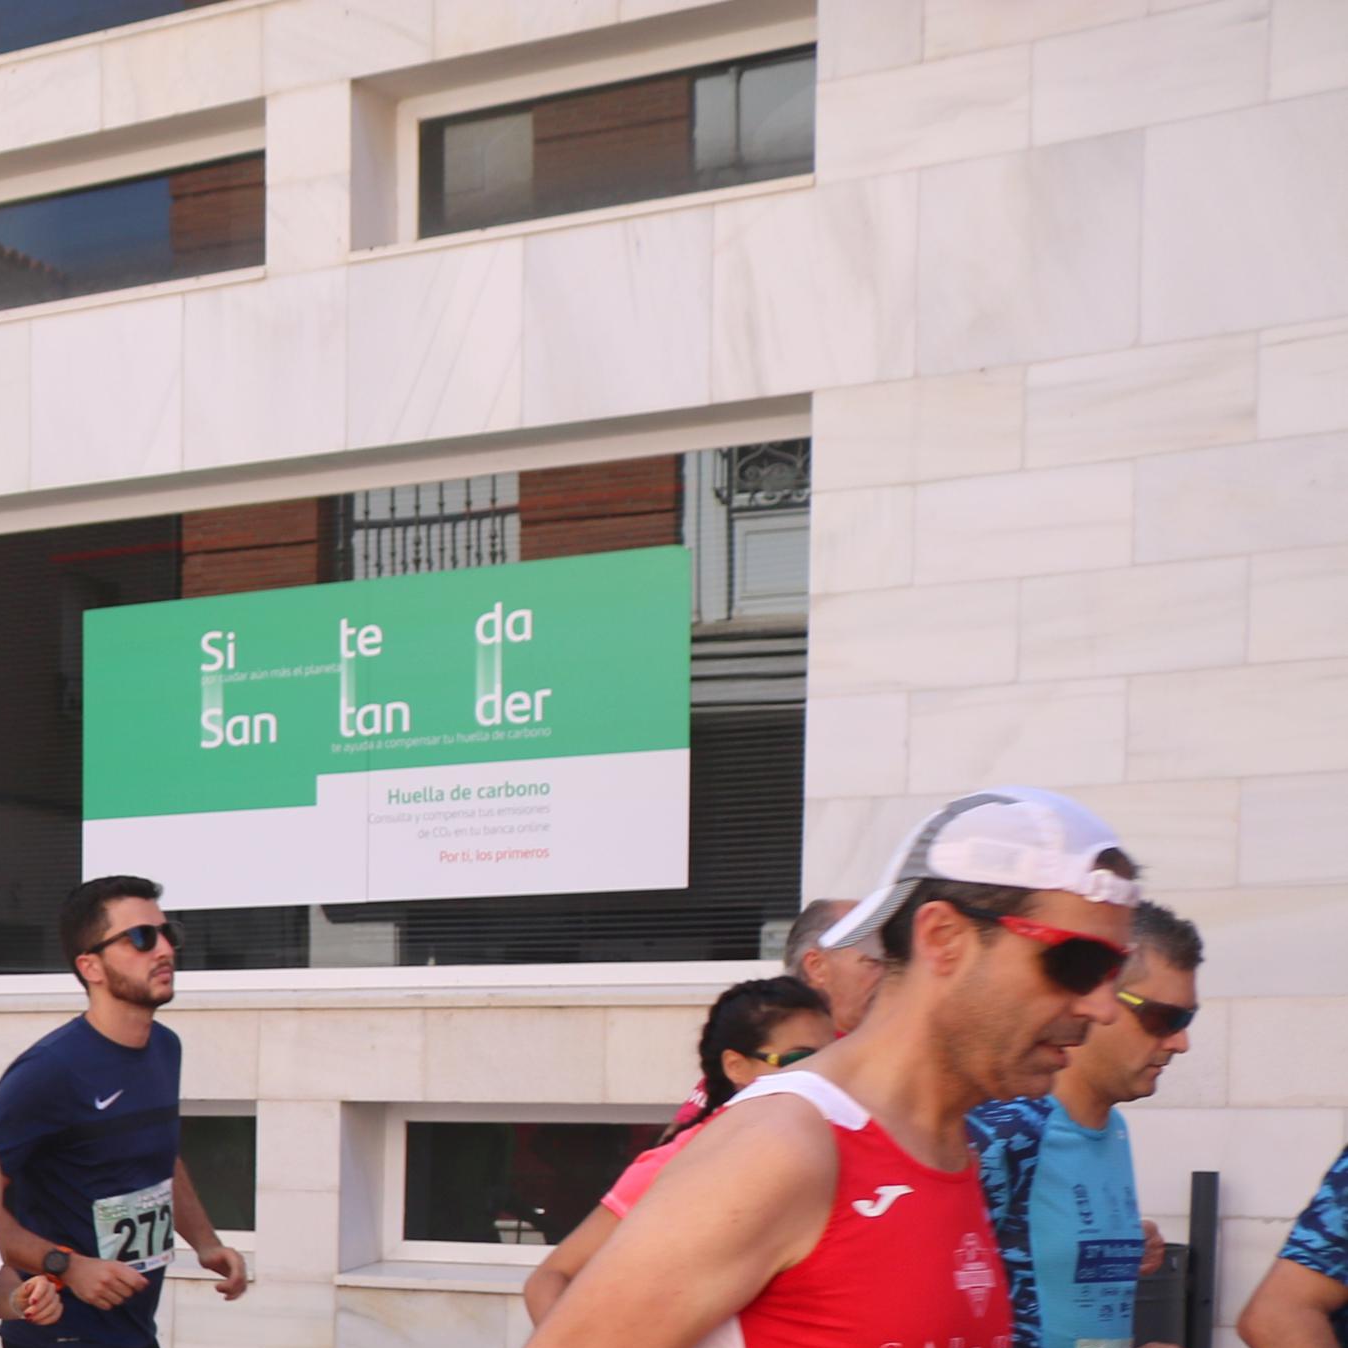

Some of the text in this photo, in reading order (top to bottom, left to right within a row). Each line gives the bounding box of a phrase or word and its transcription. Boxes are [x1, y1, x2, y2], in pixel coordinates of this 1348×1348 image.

[200, 602, 532, 671] Si te da
[200, 684, 552, 749] San tan der
[344, 739, 374, 755] ayuda
[385, 735, 441, 752] compensar
[456, 730, 490, 743] huella
[492, 729, 505, 741] de
[507, 725, 552, 740] carbono
[387, 782, 550, 805] Huella de carbono
[497, 803, 551, 817] emisiones
[418, 828, 431, 839] de
[483, 822, 515, 836] banca
[439, 850, 457, 863] Por
[476, 849, 493, 862] los
[495, 846, 551, 863] primeros
[113, 1204, 174, 1262] 272
